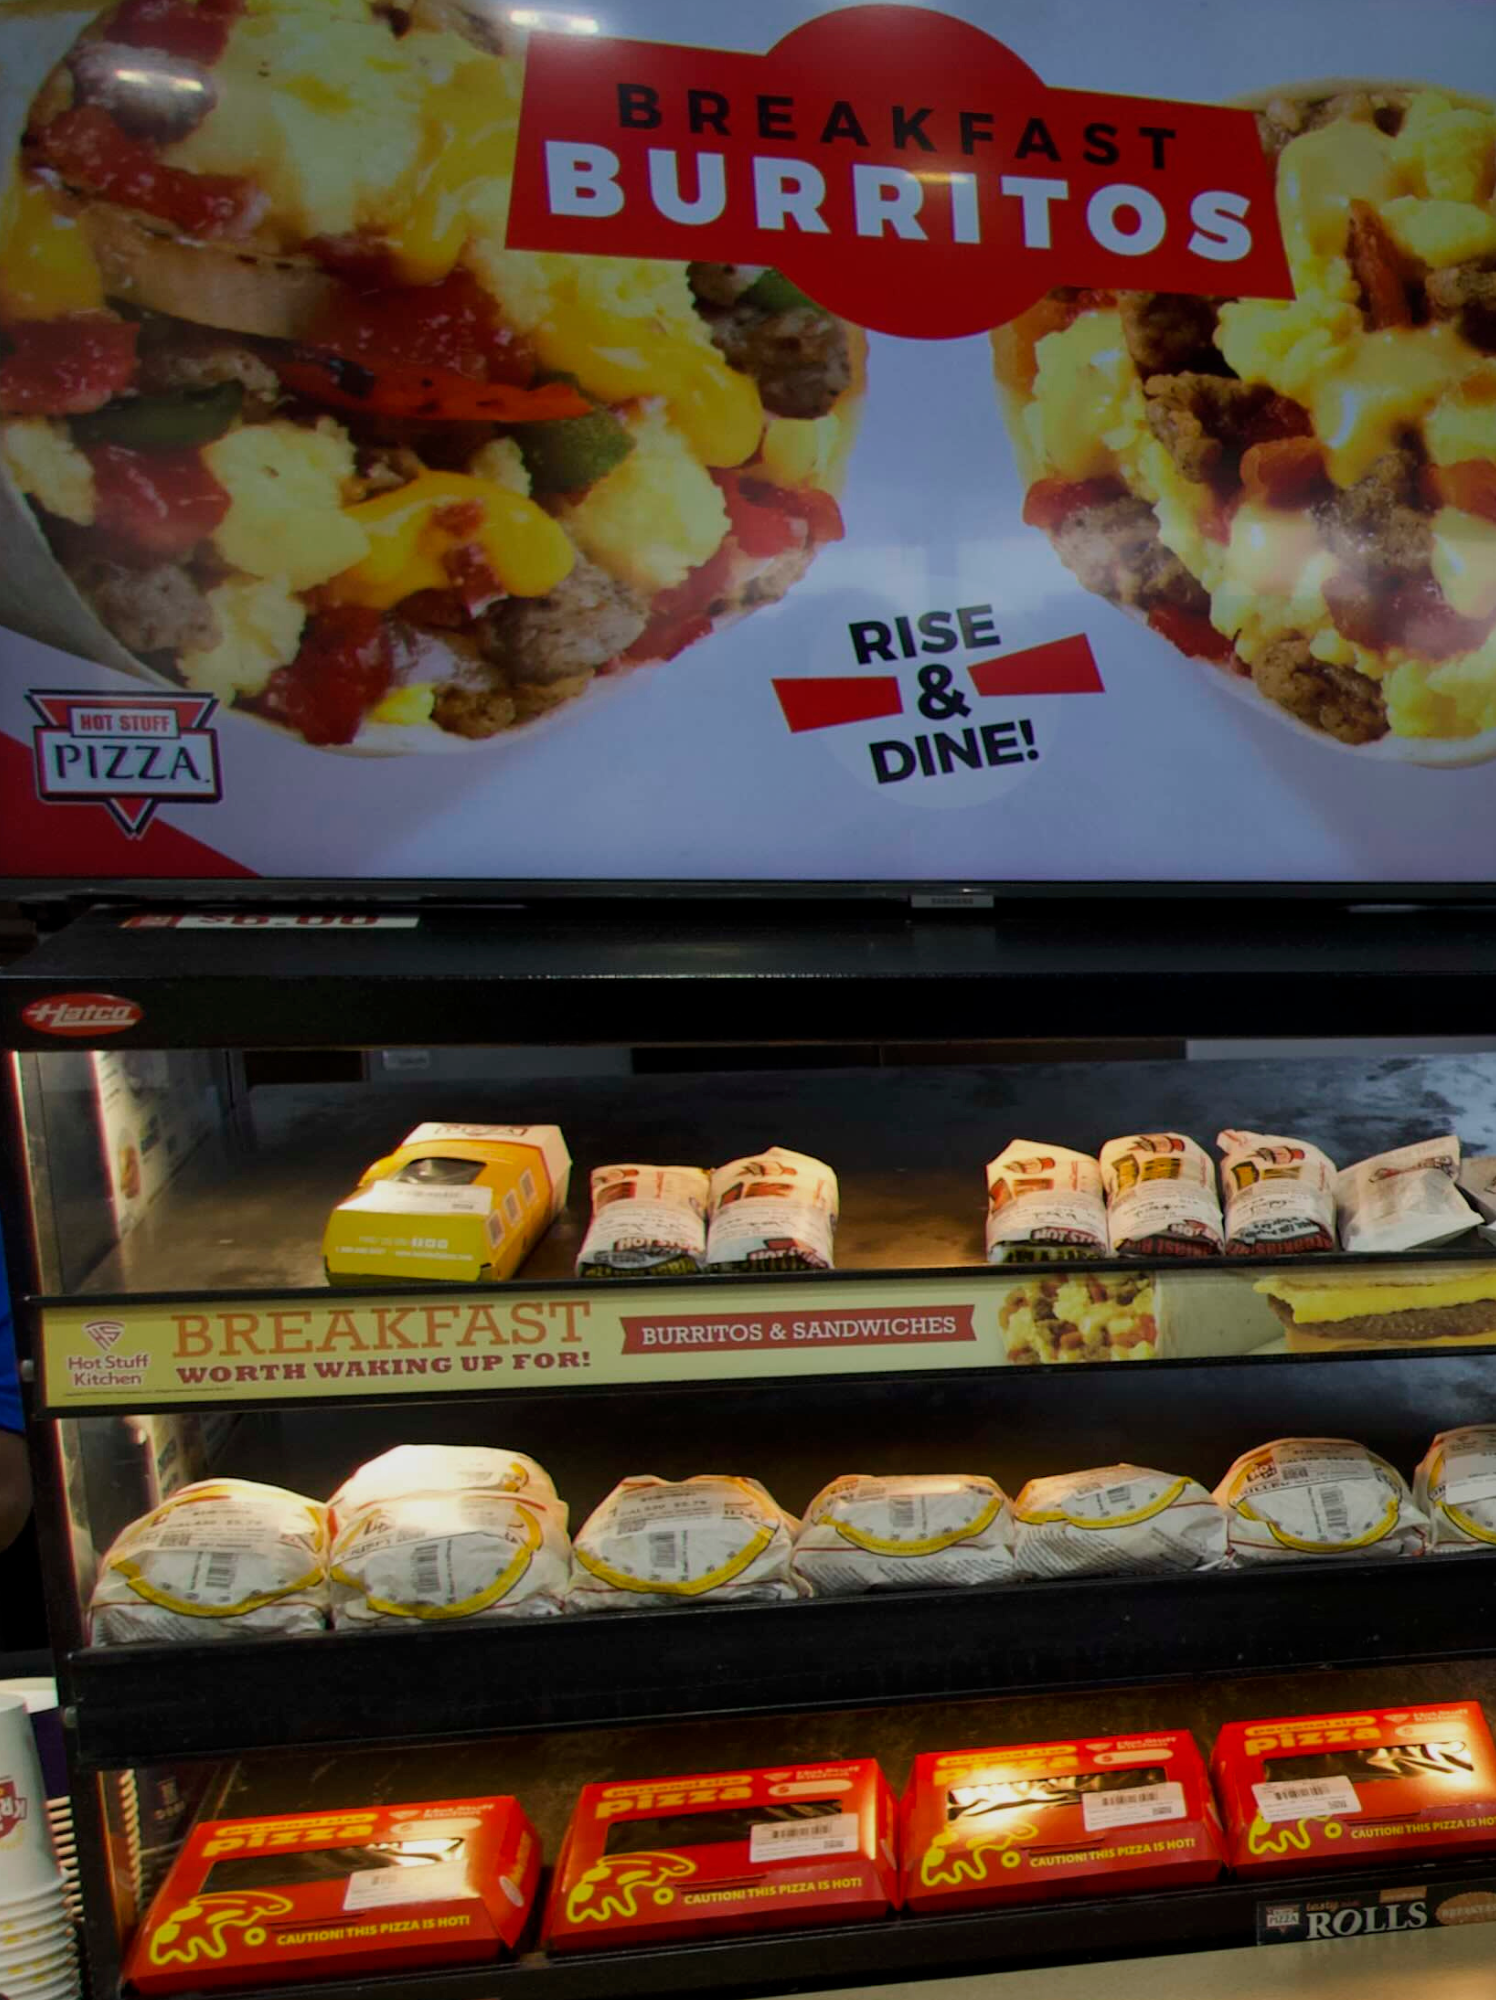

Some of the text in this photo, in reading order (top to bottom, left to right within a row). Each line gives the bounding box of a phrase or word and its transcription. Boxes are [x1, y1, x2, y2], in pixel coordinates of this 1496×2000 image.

[616, 82, 1177, 170] BREAKFAST
[543, 139, 1254, 263] BURRITOS
[848, 604, 1002, 666] RISE
[917, 663, 972, 721] &
[79, 714, 170, 732] HOT STUFF
[868, 718, 1040, 785] DINE!
[27, 1003, 137, 1027] Hatco
[169, 1300, 591, 1359] BREAKFAST
[641, 1316, 957, 1346] BURRITOS & SANDWICHES
[67, 1354, 149, 1371] Hot Stuff
[174, 1350, 592, 1385] WORTH WAKING UP FOR!
[73, 1371, 142, 1387] Kitchen
[1244, 1725, 1382, 1757] pizza
[594, 1785, 754, 1819] pizza
[200, 1824, 375, 1857] pizza
[1350, 1823, 1404, 1839] CAUTION!
[1405, 1820, 1431, 1833] THIS
[1432, 1818, 1465, 1831] PIZZA
[1466, 1817, 1477, 1828] IS
[1029, 1837, 1196, 1868] CAUTION! THIS PIZZA IS HOT!
[683, 1876, 863, 1905] CAUTION! THIS PIZZA IS HOT!
[276, 1914, 471, 1946] CAUTION! THIS PIZZA IS HOT!
[1306, 1901, 1429, 1940] ROLLS
